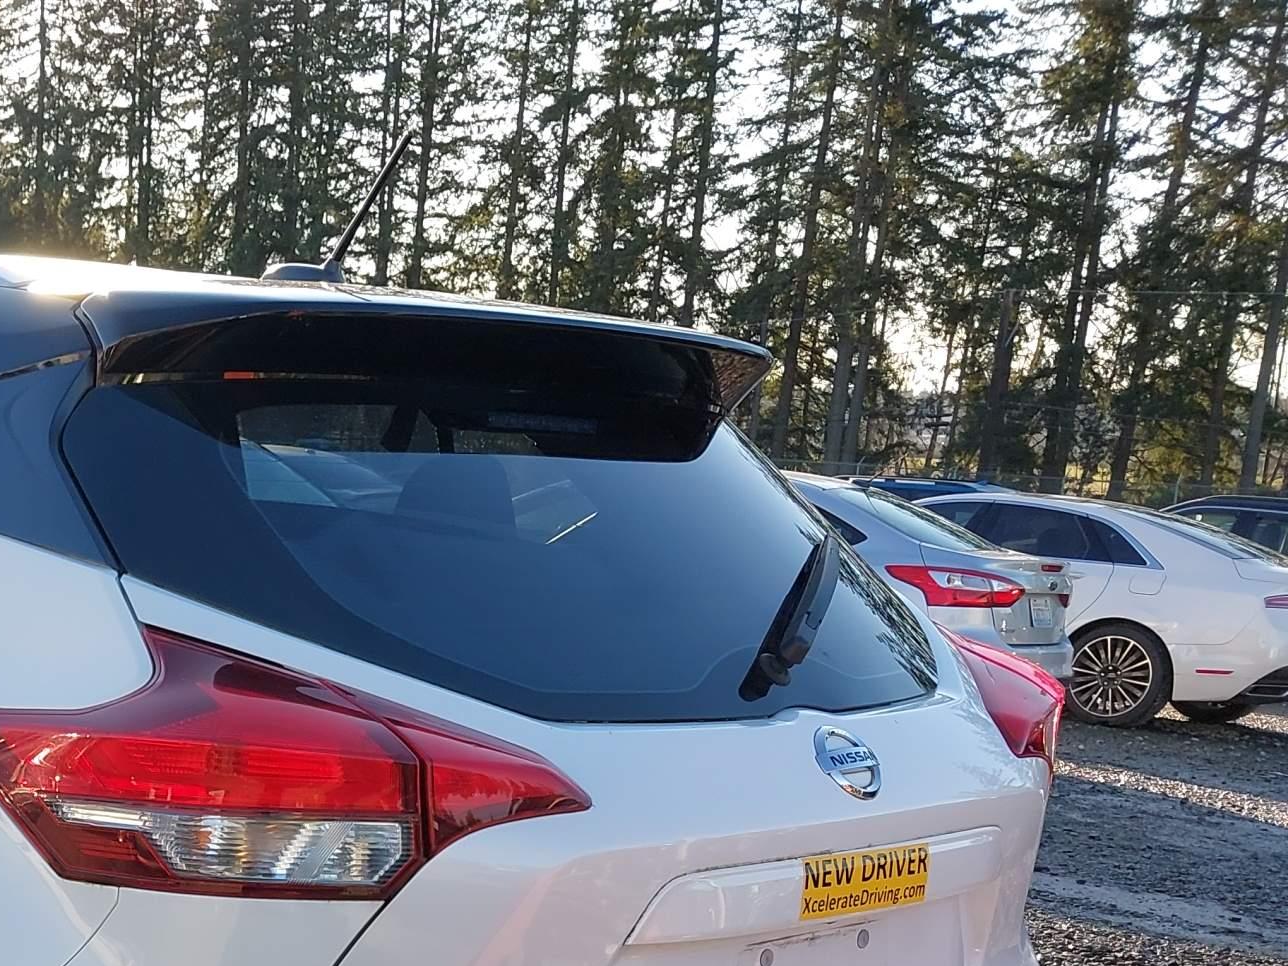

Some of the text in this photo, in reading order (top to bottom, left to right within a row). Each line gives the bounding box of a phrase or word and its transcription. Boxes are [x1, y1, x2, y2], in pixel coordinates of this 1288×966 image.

[830, 746, 878, 767] NISSAN
[804, 847, 928, 890] NEW DRIVER
[802, 882, 926, 915] XcelerateDriving.com
